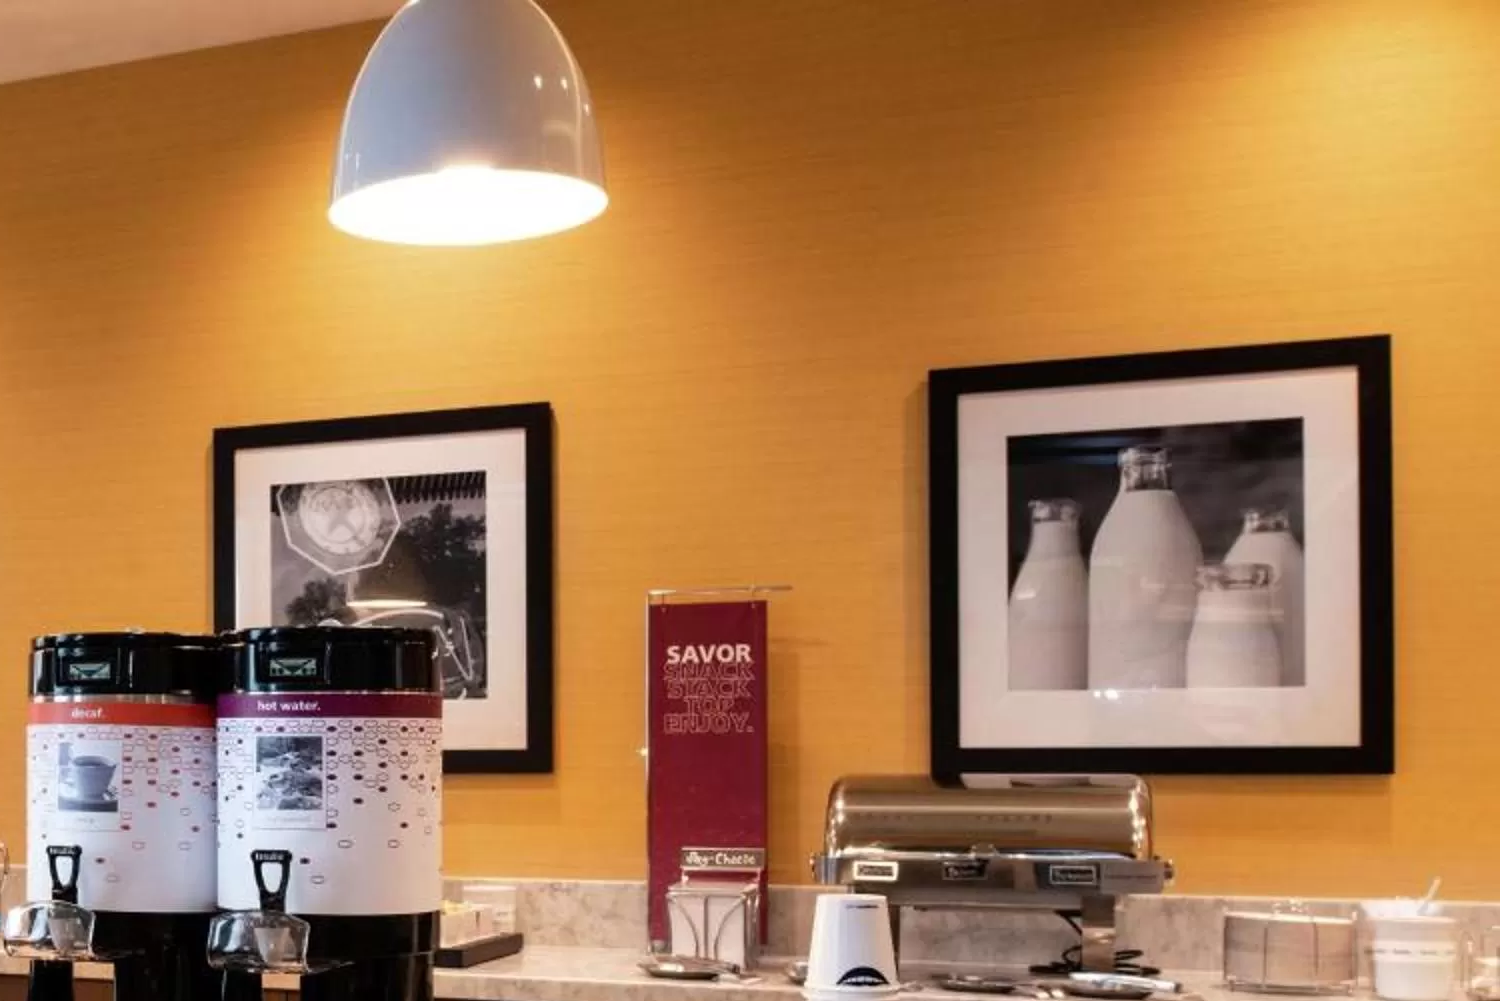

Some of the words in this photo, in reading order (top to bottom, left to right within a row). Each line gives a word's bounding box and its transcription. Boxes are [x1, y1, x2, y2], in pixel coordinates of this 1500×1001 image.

[666, 643, 753, 664] SAVOR
[663, 661, 756, 681] SNACK
[666, 677, 754, 699] STACK
[257, 700, 276, 712] hot
[280, 701, 321, 712] water.
[663, 712, 755, 734] ENJOY.
